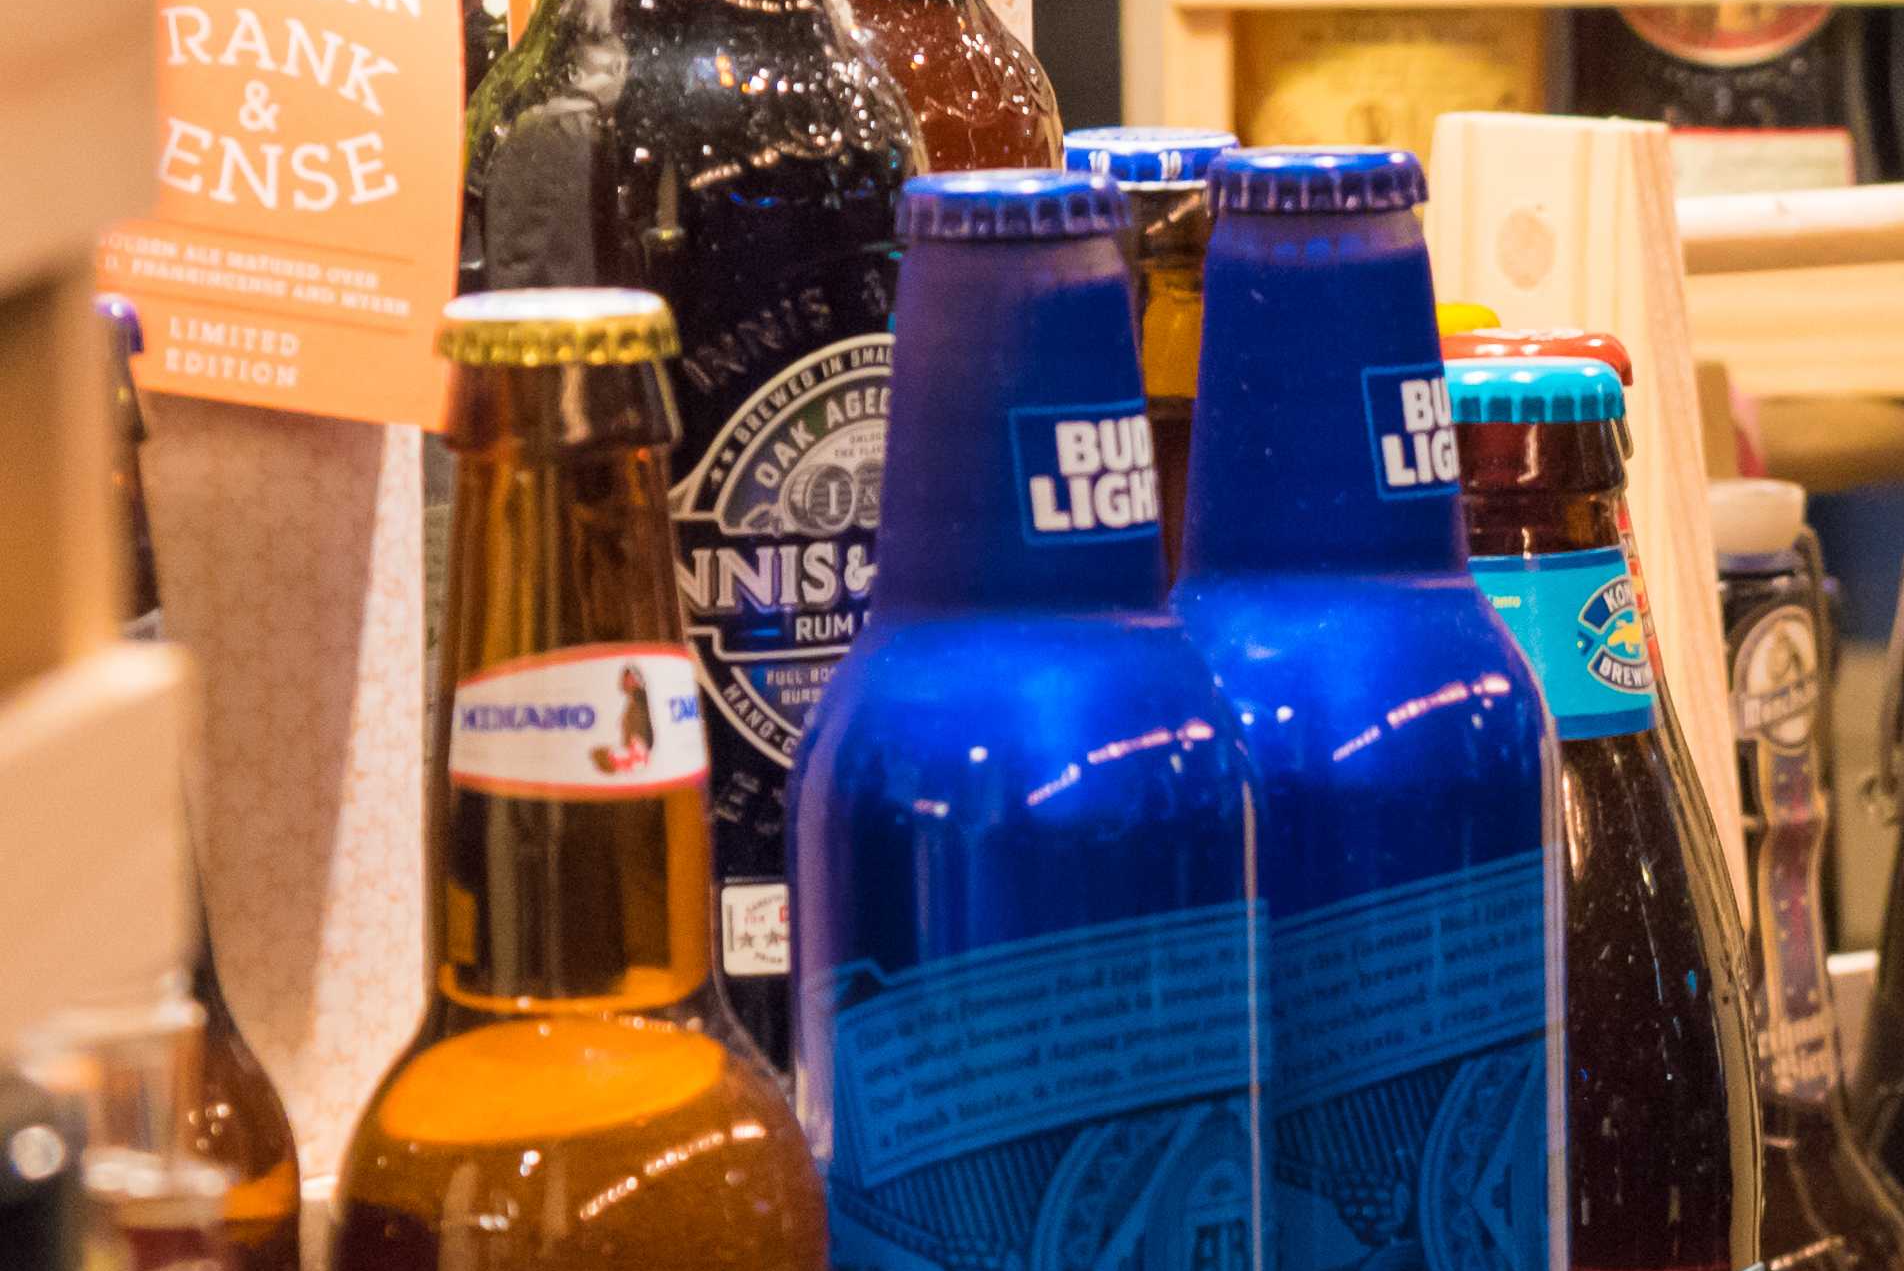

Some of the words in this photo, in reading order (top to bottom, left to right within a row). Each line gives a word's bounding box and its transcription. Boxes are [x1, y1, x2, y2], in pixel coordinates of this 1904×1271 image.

[240, 80, 280, 133] &
[169, 316, 300, 357] LIMITED
[166, 349, 298, 388] EDITION
[736, 370, 818, 444] BREWED
[822, 355, 844, 377] IN
[755, 420, 816, 490] OAK
[796, 613, 854, 642] RUM
